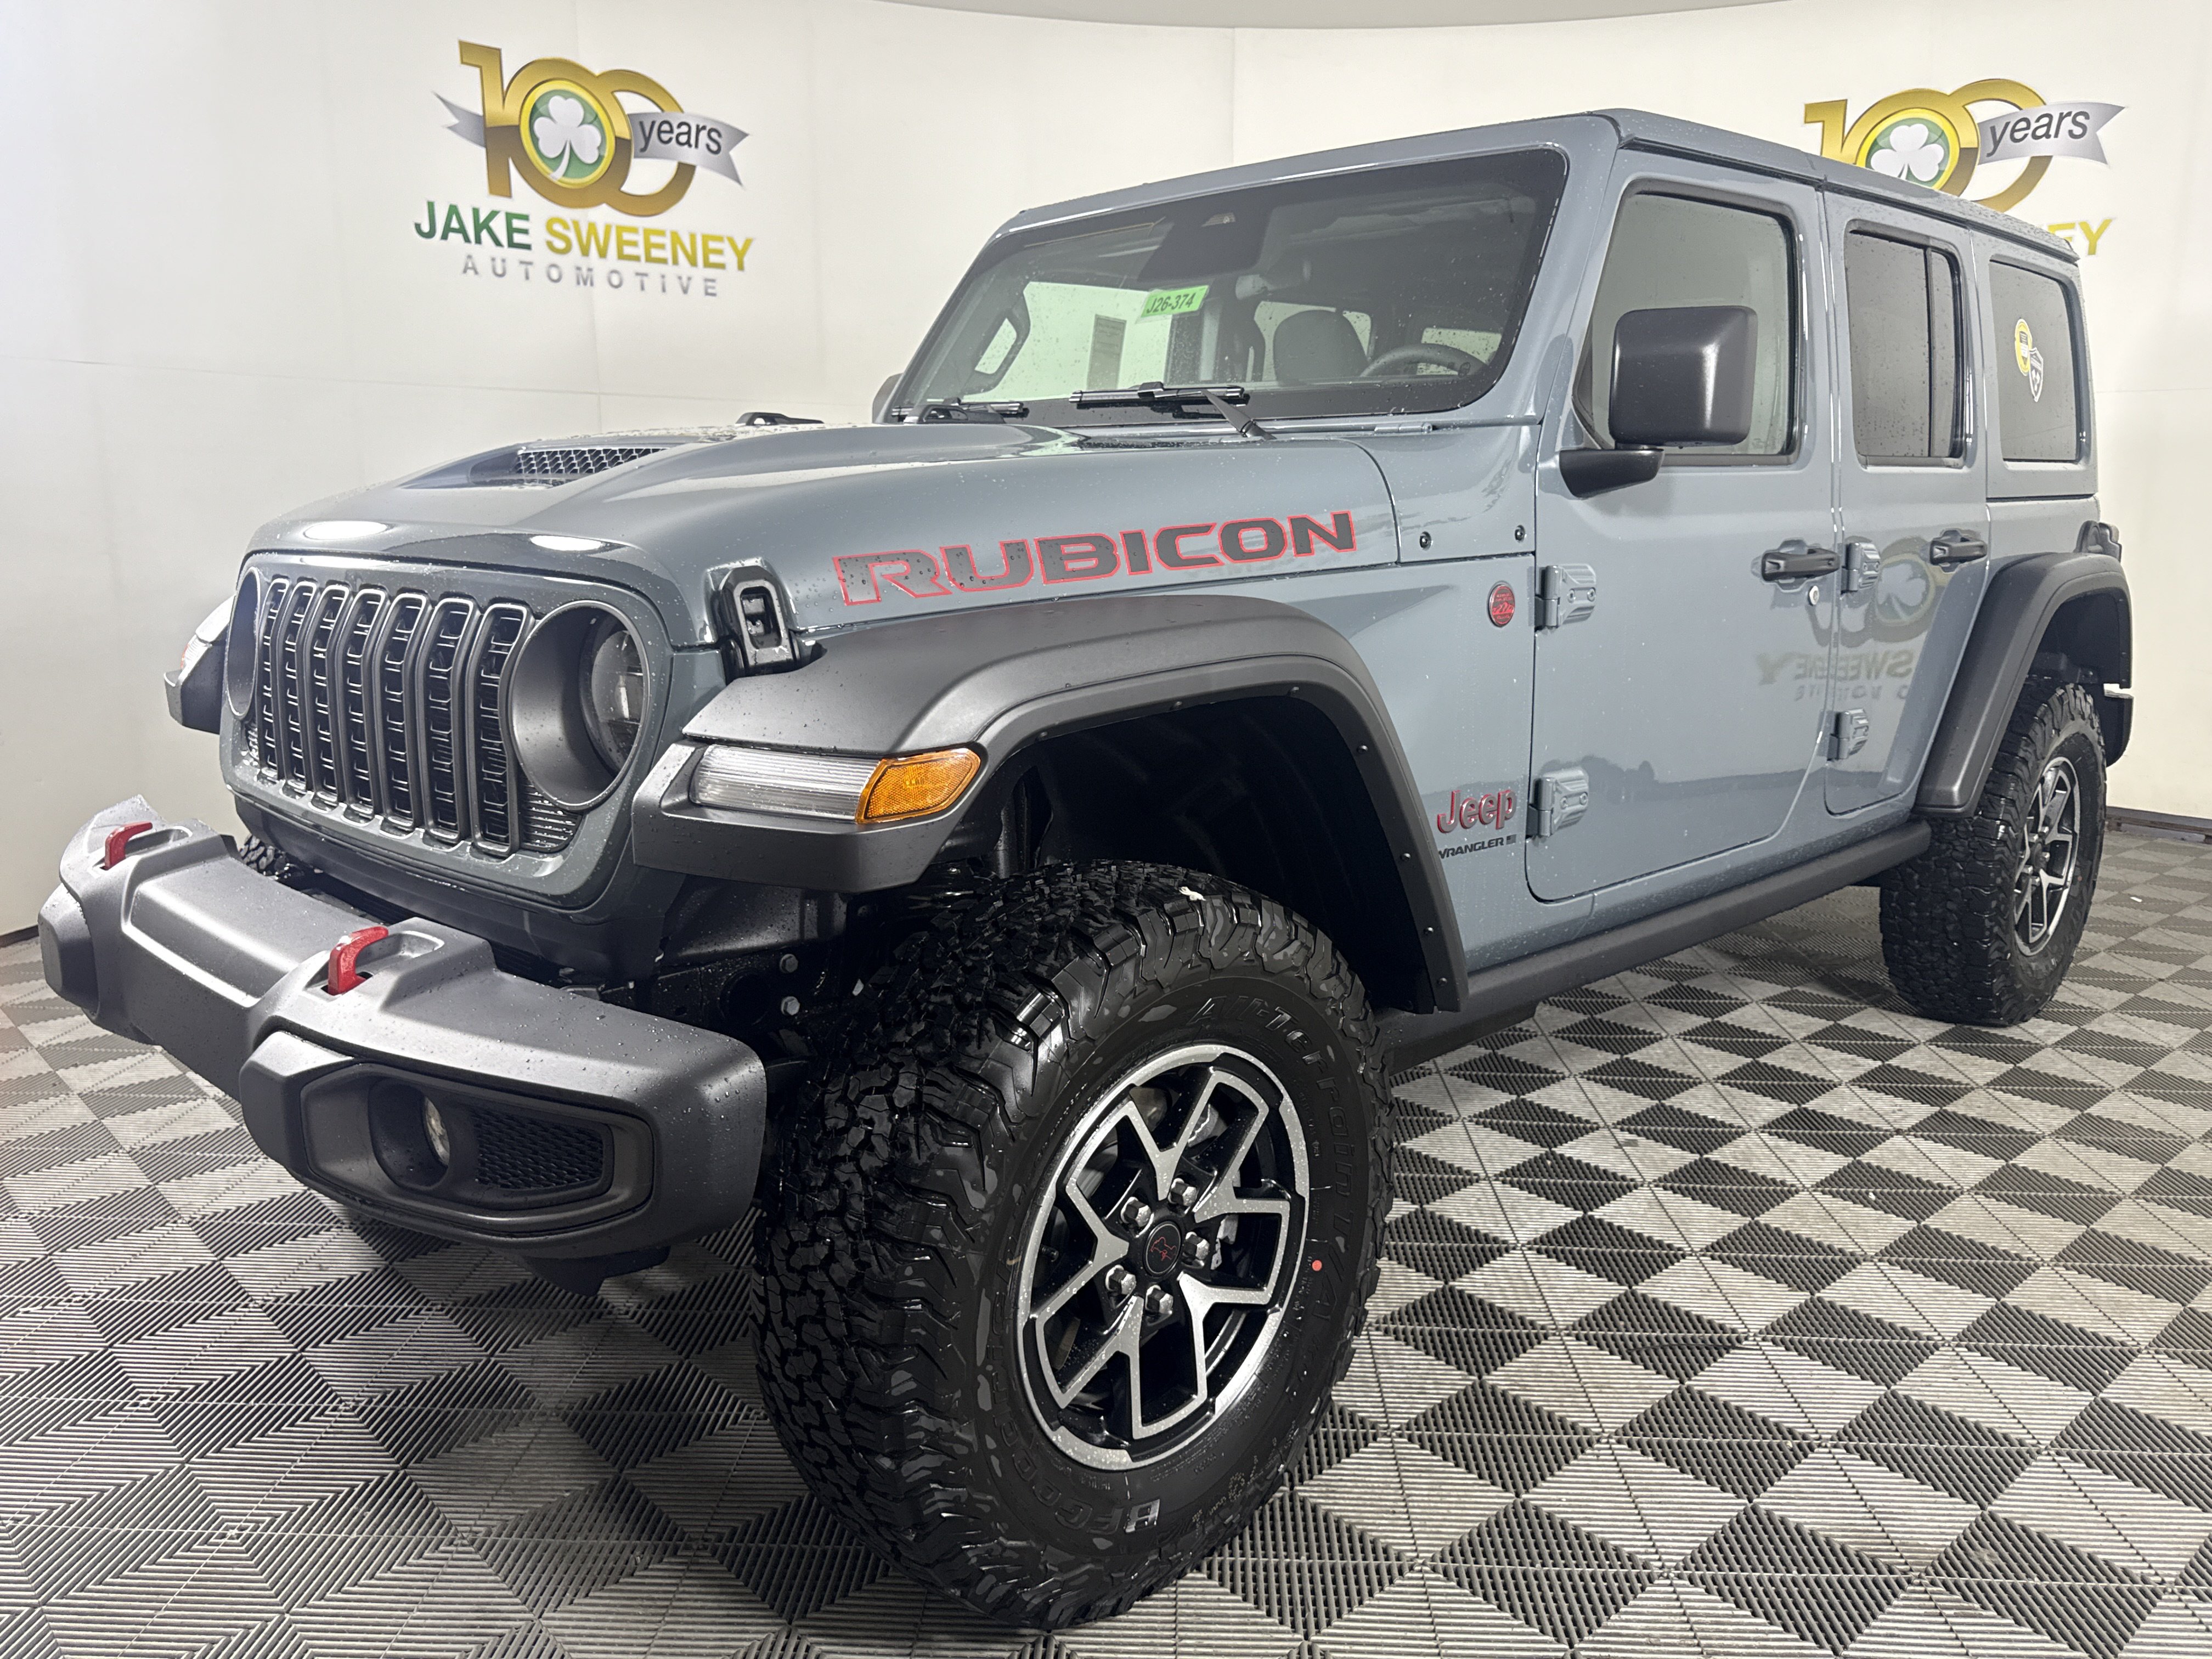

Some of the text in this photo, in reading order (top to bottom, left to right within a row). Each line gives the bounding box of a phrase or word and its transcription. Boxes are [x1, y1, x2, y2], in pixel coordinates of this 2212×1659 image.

[458, 39, 696, 217] 100
[638, 117, 723, 155] years
[1986, 109, 2091, 158] years
[414, 200, 754, 272] JAKE SWEENEY
[462, 254, 718, 297] AUTOMOTIVE
[1146, 291, 1197, 314] J26-374
[833, 511, 1357, 606] RUBICON
[1437, 789, 1517, 834] Jeep
